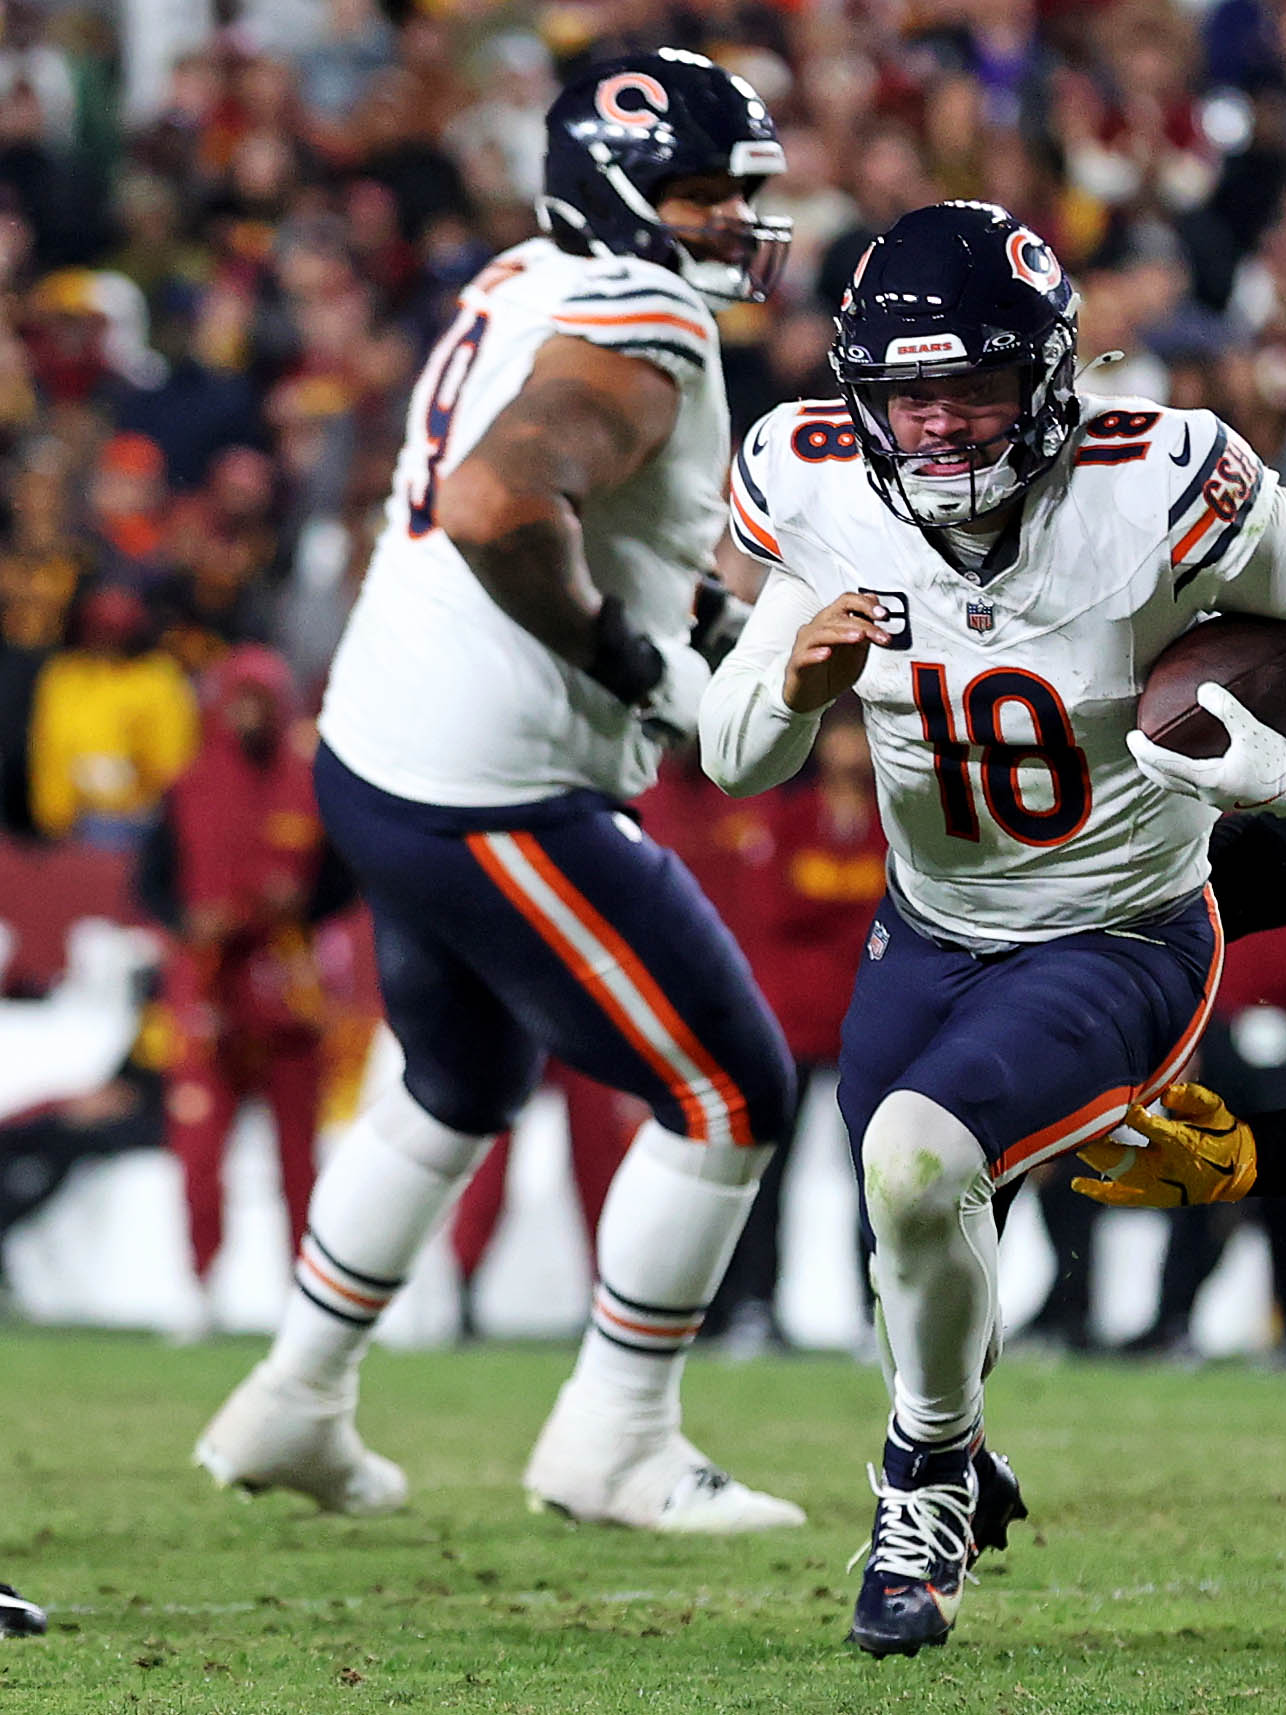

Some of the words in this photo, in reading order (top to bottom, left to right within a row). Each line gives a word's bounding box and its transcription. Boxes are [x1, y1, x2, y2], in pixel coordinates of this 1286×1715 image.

[897, 341, 953, 355] BEARS
[1075, 410, 1163, 466] 18
[1202, 439, 1259, 522] GSH
[910, 661, 1093, 848] 18
